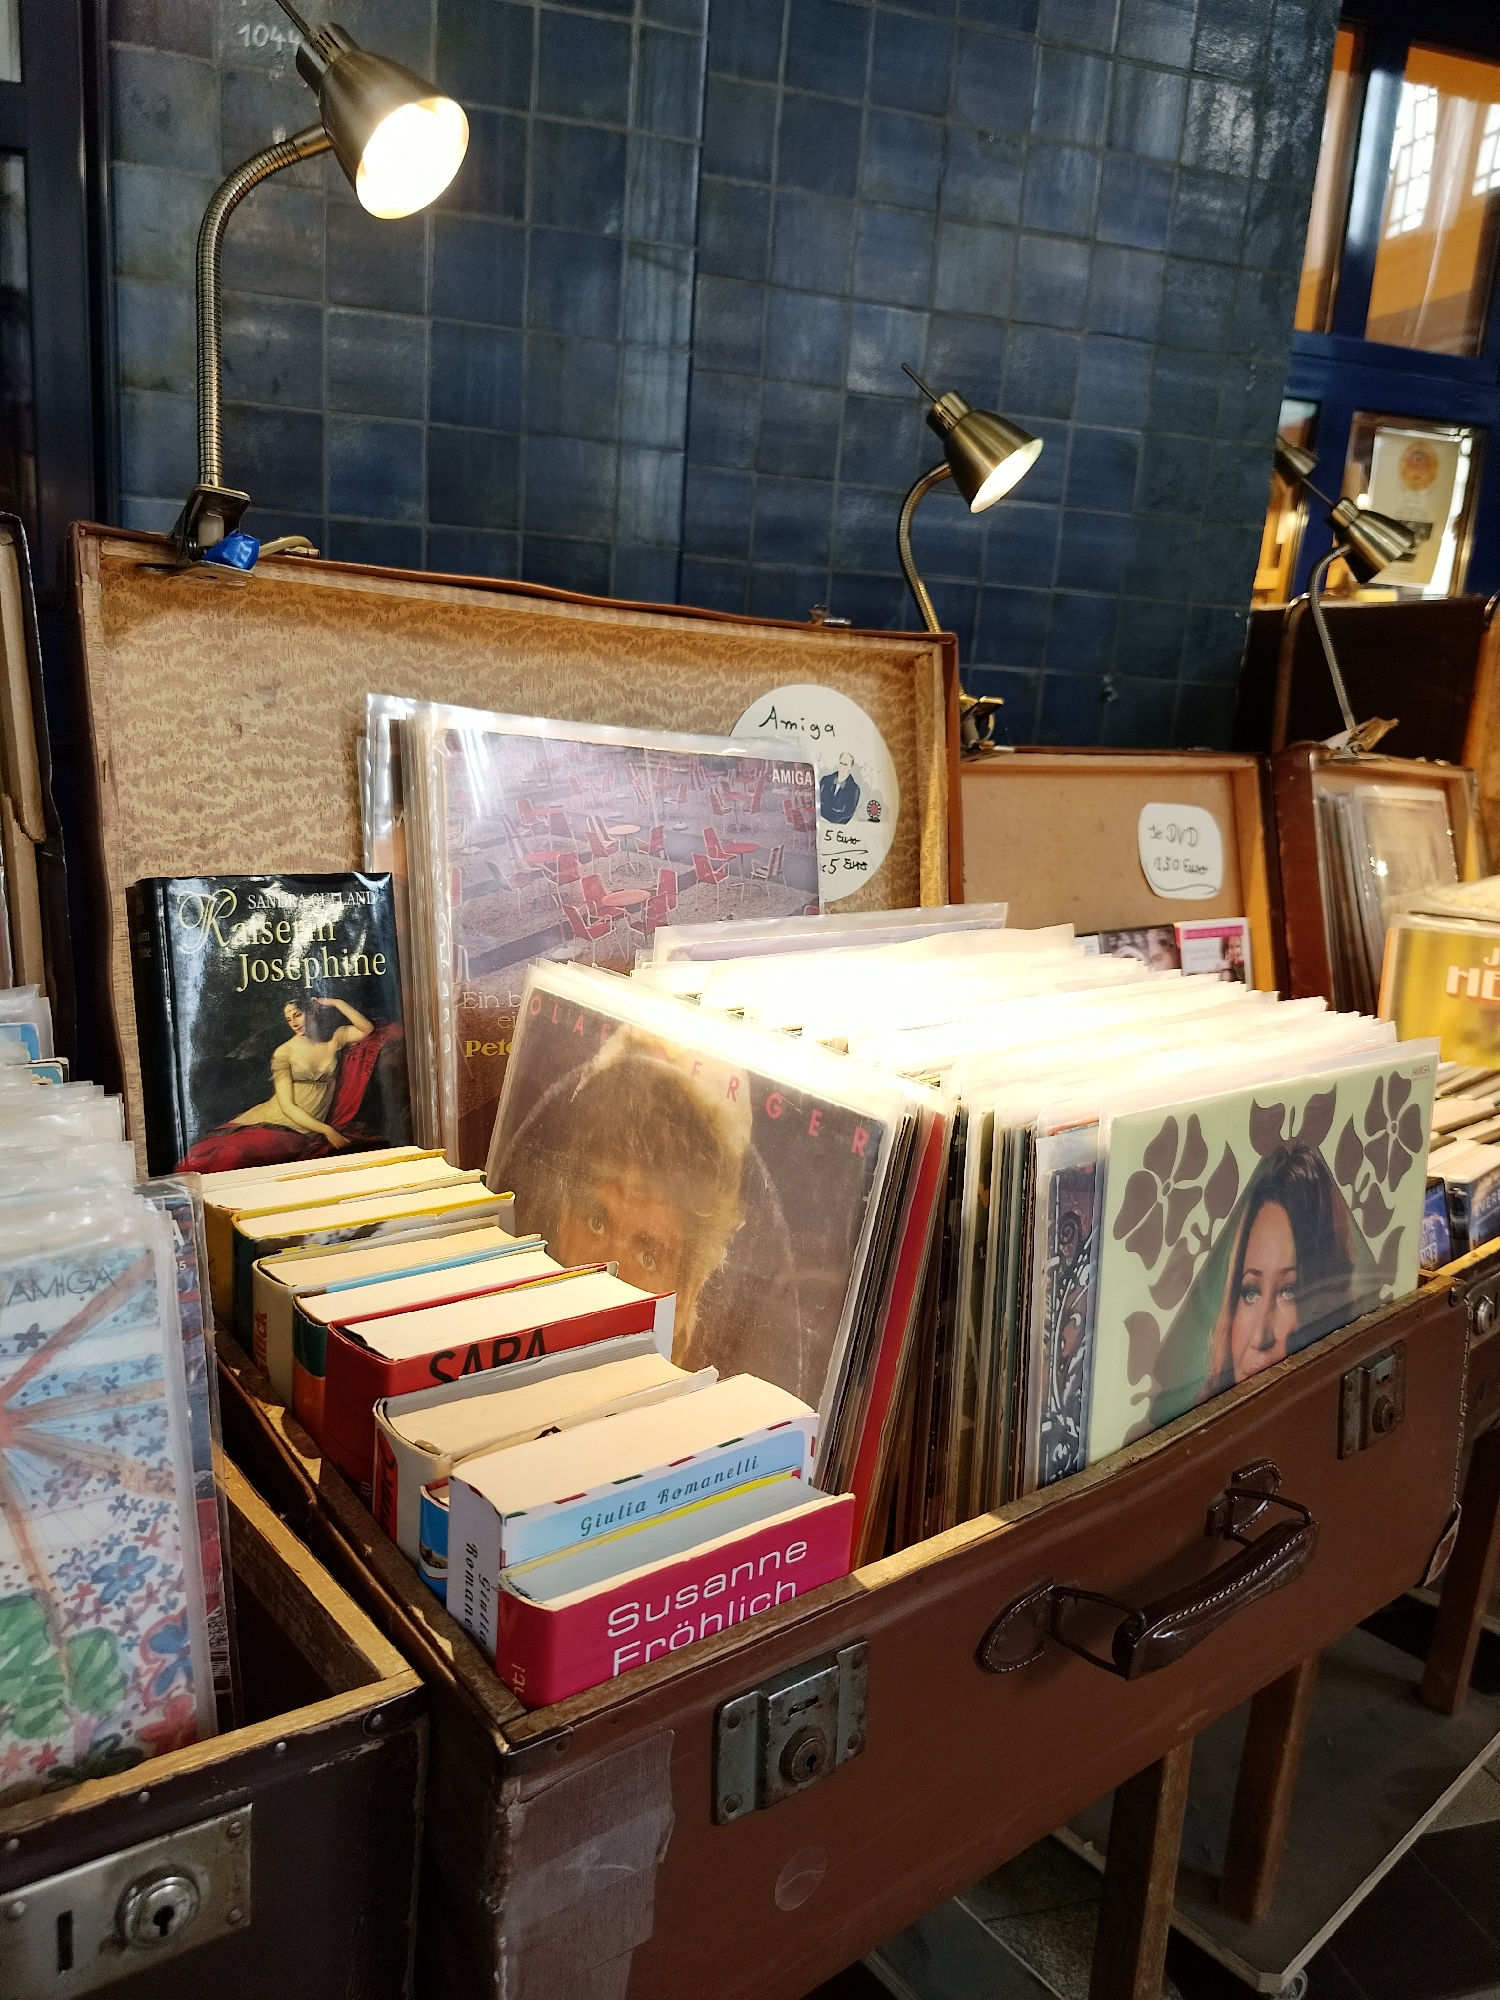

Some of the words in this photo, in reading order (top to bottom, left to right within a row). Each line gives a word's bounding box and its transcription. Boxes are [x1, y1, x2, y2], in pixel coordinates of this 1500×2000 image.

[759, 706, 836, 740] Amiga
[771, 768, 813, 787] AMIGA
[836, 830, 862, 845] Euro
[1165, 823, 1199, 848] DVD
[843, 858, 868, 871] Euro
[1183, 857, 1209, 875] Euro
[248, 893, 307, 910] SANDRA
[236, 946, 387, 993] Josephine
[462, 991, 501, 1009] Ein
[508, 991, 522, 1009] b
[6, 1265, 117, 1307] AMIGA
[581, 1499, 648, 1538] Giulia
[657, 1456, 760, 1505] Romanelli
[464, 1542, 479, 1630] Romane
[606, 1540, 809, 1638] Susanne
[612, 1579, 798, 1678] Fröhlich
